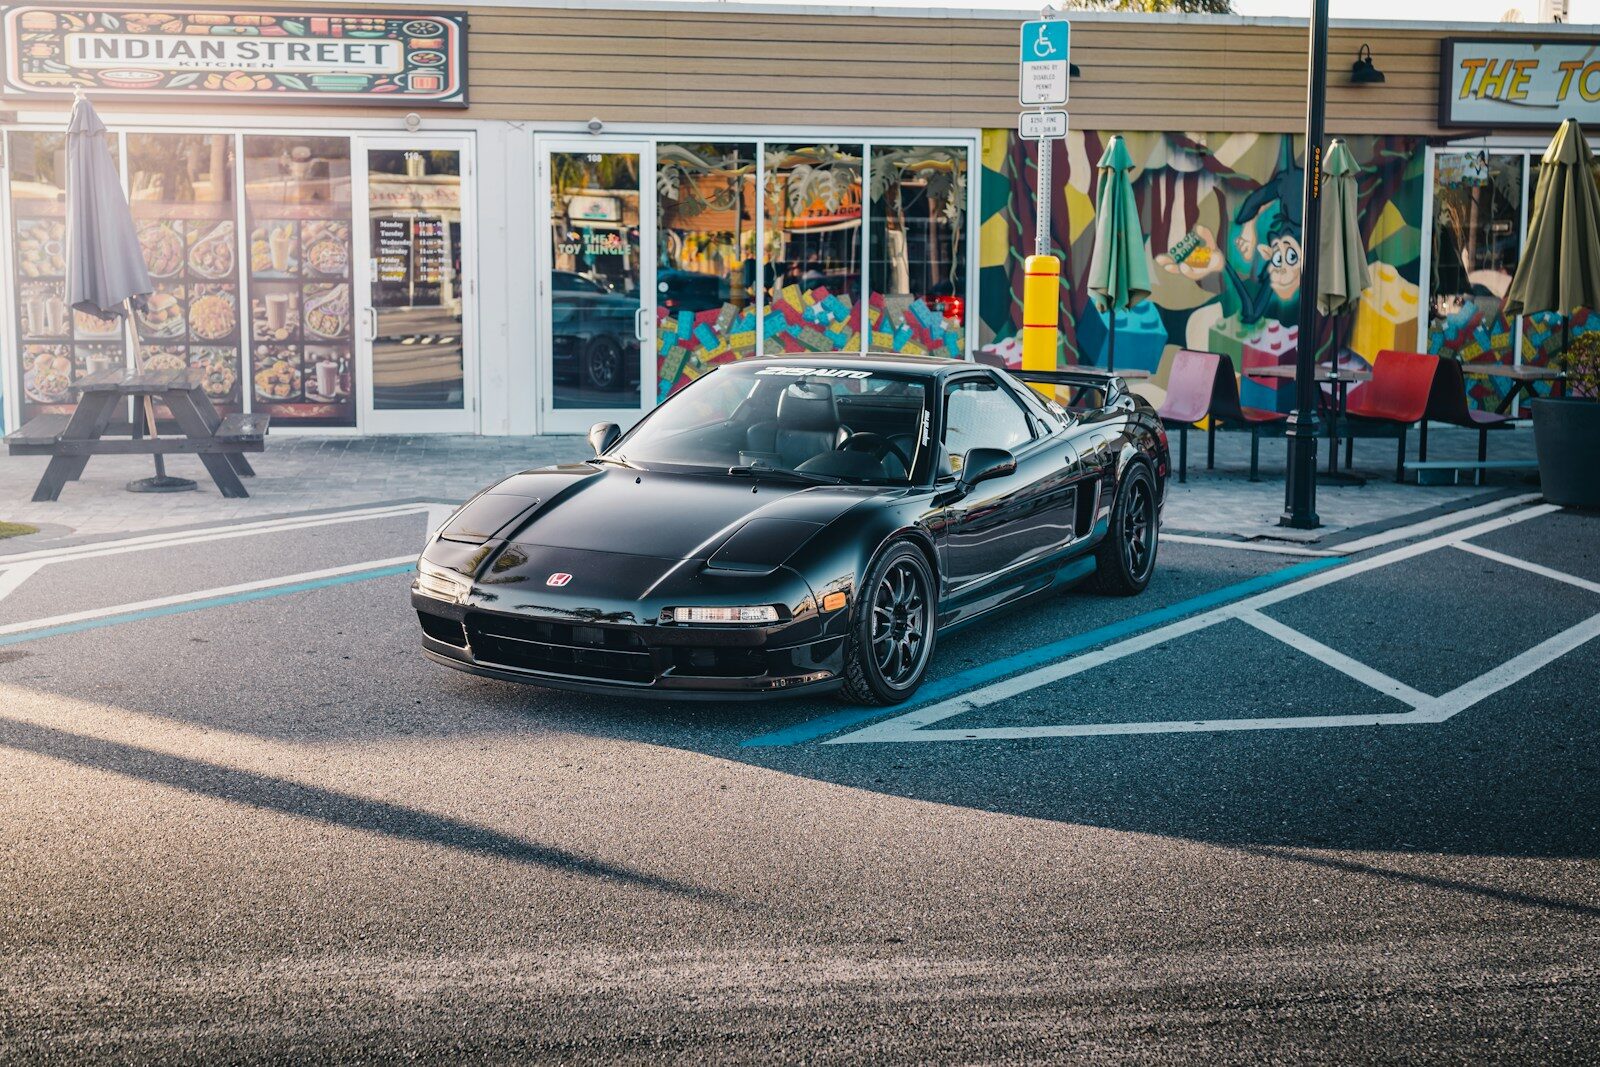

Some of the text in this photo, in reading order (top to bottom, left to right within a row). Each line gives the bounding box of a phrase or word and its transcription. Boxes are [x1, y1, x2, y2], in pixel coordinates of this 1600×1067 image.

[78, 38, 390, 65] INDIAN STREET
[178, 61, 274, 69] KITCHEN
[1459, 58, 1540, 101] THE
[380, 221, 403, 229] Monday
[380, 230, 404, 238] Tuesday
[583, 234, 607, 244] THE
[381, 248, 408, 256] Thursday
[559, 244, 631, 255] TOY JUNGLE
